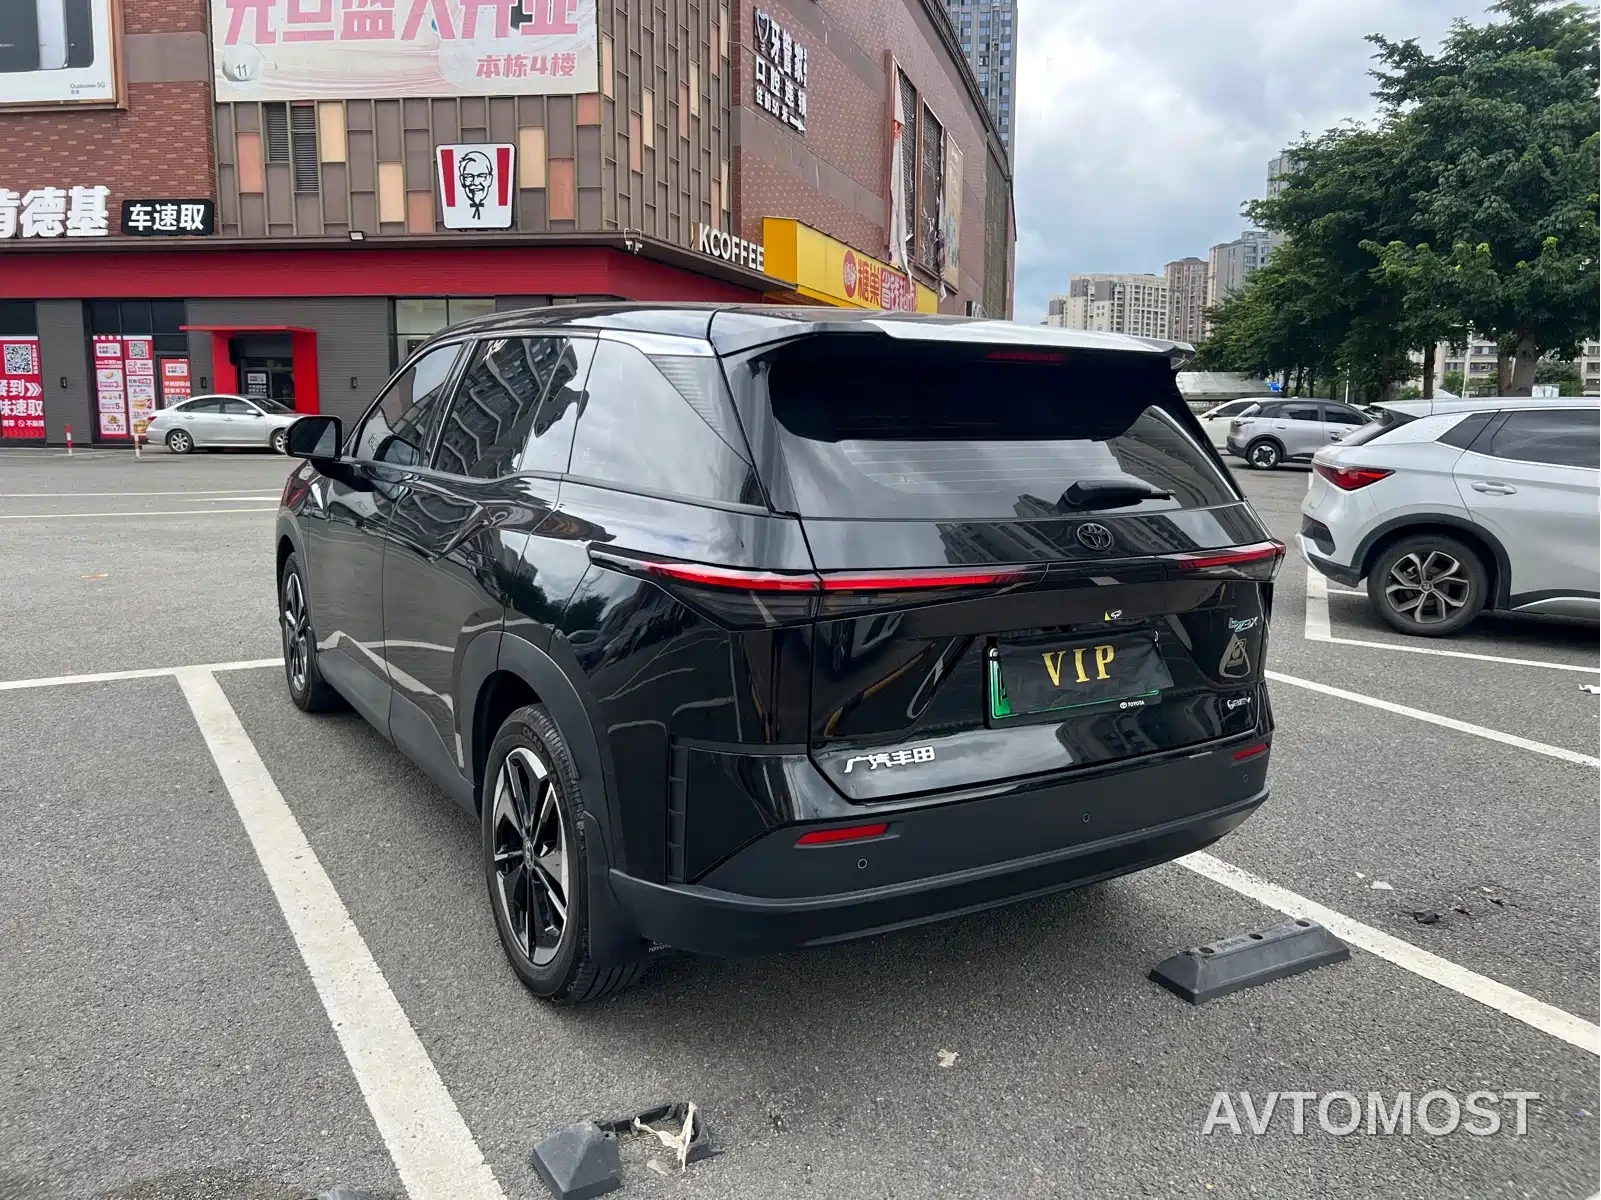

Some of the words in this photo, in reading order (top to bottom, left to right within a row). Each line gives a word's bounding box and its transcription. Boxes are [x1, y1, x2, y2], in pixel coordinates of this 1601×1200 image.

[236, 64, 247, 77] 11
[476, 53, 577, 78] 本栋4楼
[129, 204, 205, 231] 车速取
[699, 222, 765, 272] KCOFFEE
[1042, 644, 1116, 687] VIP
[1127, 700, 1146, 708] TOYOTA
[843, 746, 936, 773] 广汽丰田
